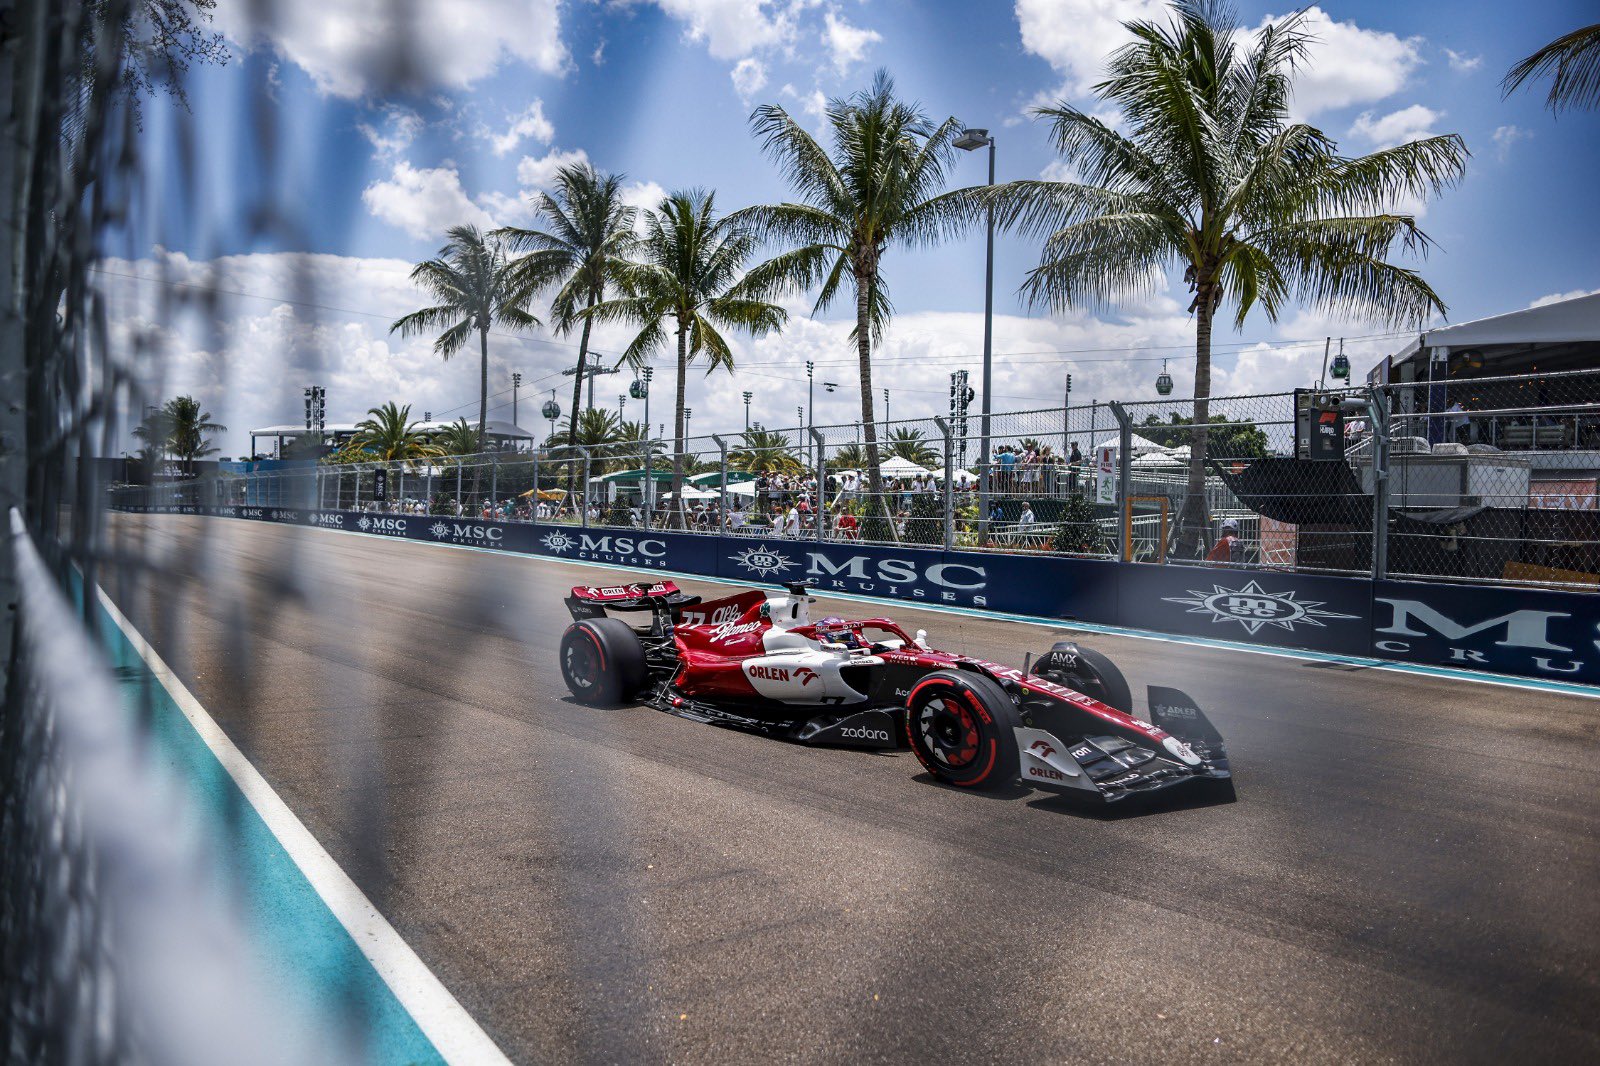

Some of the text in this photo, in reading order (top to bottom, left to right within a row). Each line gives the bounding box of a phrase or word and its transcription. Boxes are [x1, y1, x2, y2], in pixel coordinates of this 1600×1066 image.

[248, 509, 263, 517] MSC
[279, 511, 298, 520] MSC
[319, 513, 344, 525] MSC
[372, 517, 407, 531] MSC
[452, 523, 503, 540] MSC
[452, 537, 503, 547] CRUISES
[579, 534, 666, 557] MSC
[579, 551, 667, 567] CRUISES
[805, 552, 987, 590] MSC
[806, 577, 987, 606] CRUISES
[677, 611, 706, 630] 77
[711, 603, 745, 626] Alfa
[708, 620, 762, 643] Romeo
[1374, 598, 1600, 652] M
[1050, 652, 1077, 665] AMX
[1375, 640, 1584, 673] CRU
[748, 664, 790, 682] ORLEN
[1167, 705, 1196, 716] ADLER
[840, 725, 889, 741] zadara
[1029, 767, 1063, 780] ORLEN
